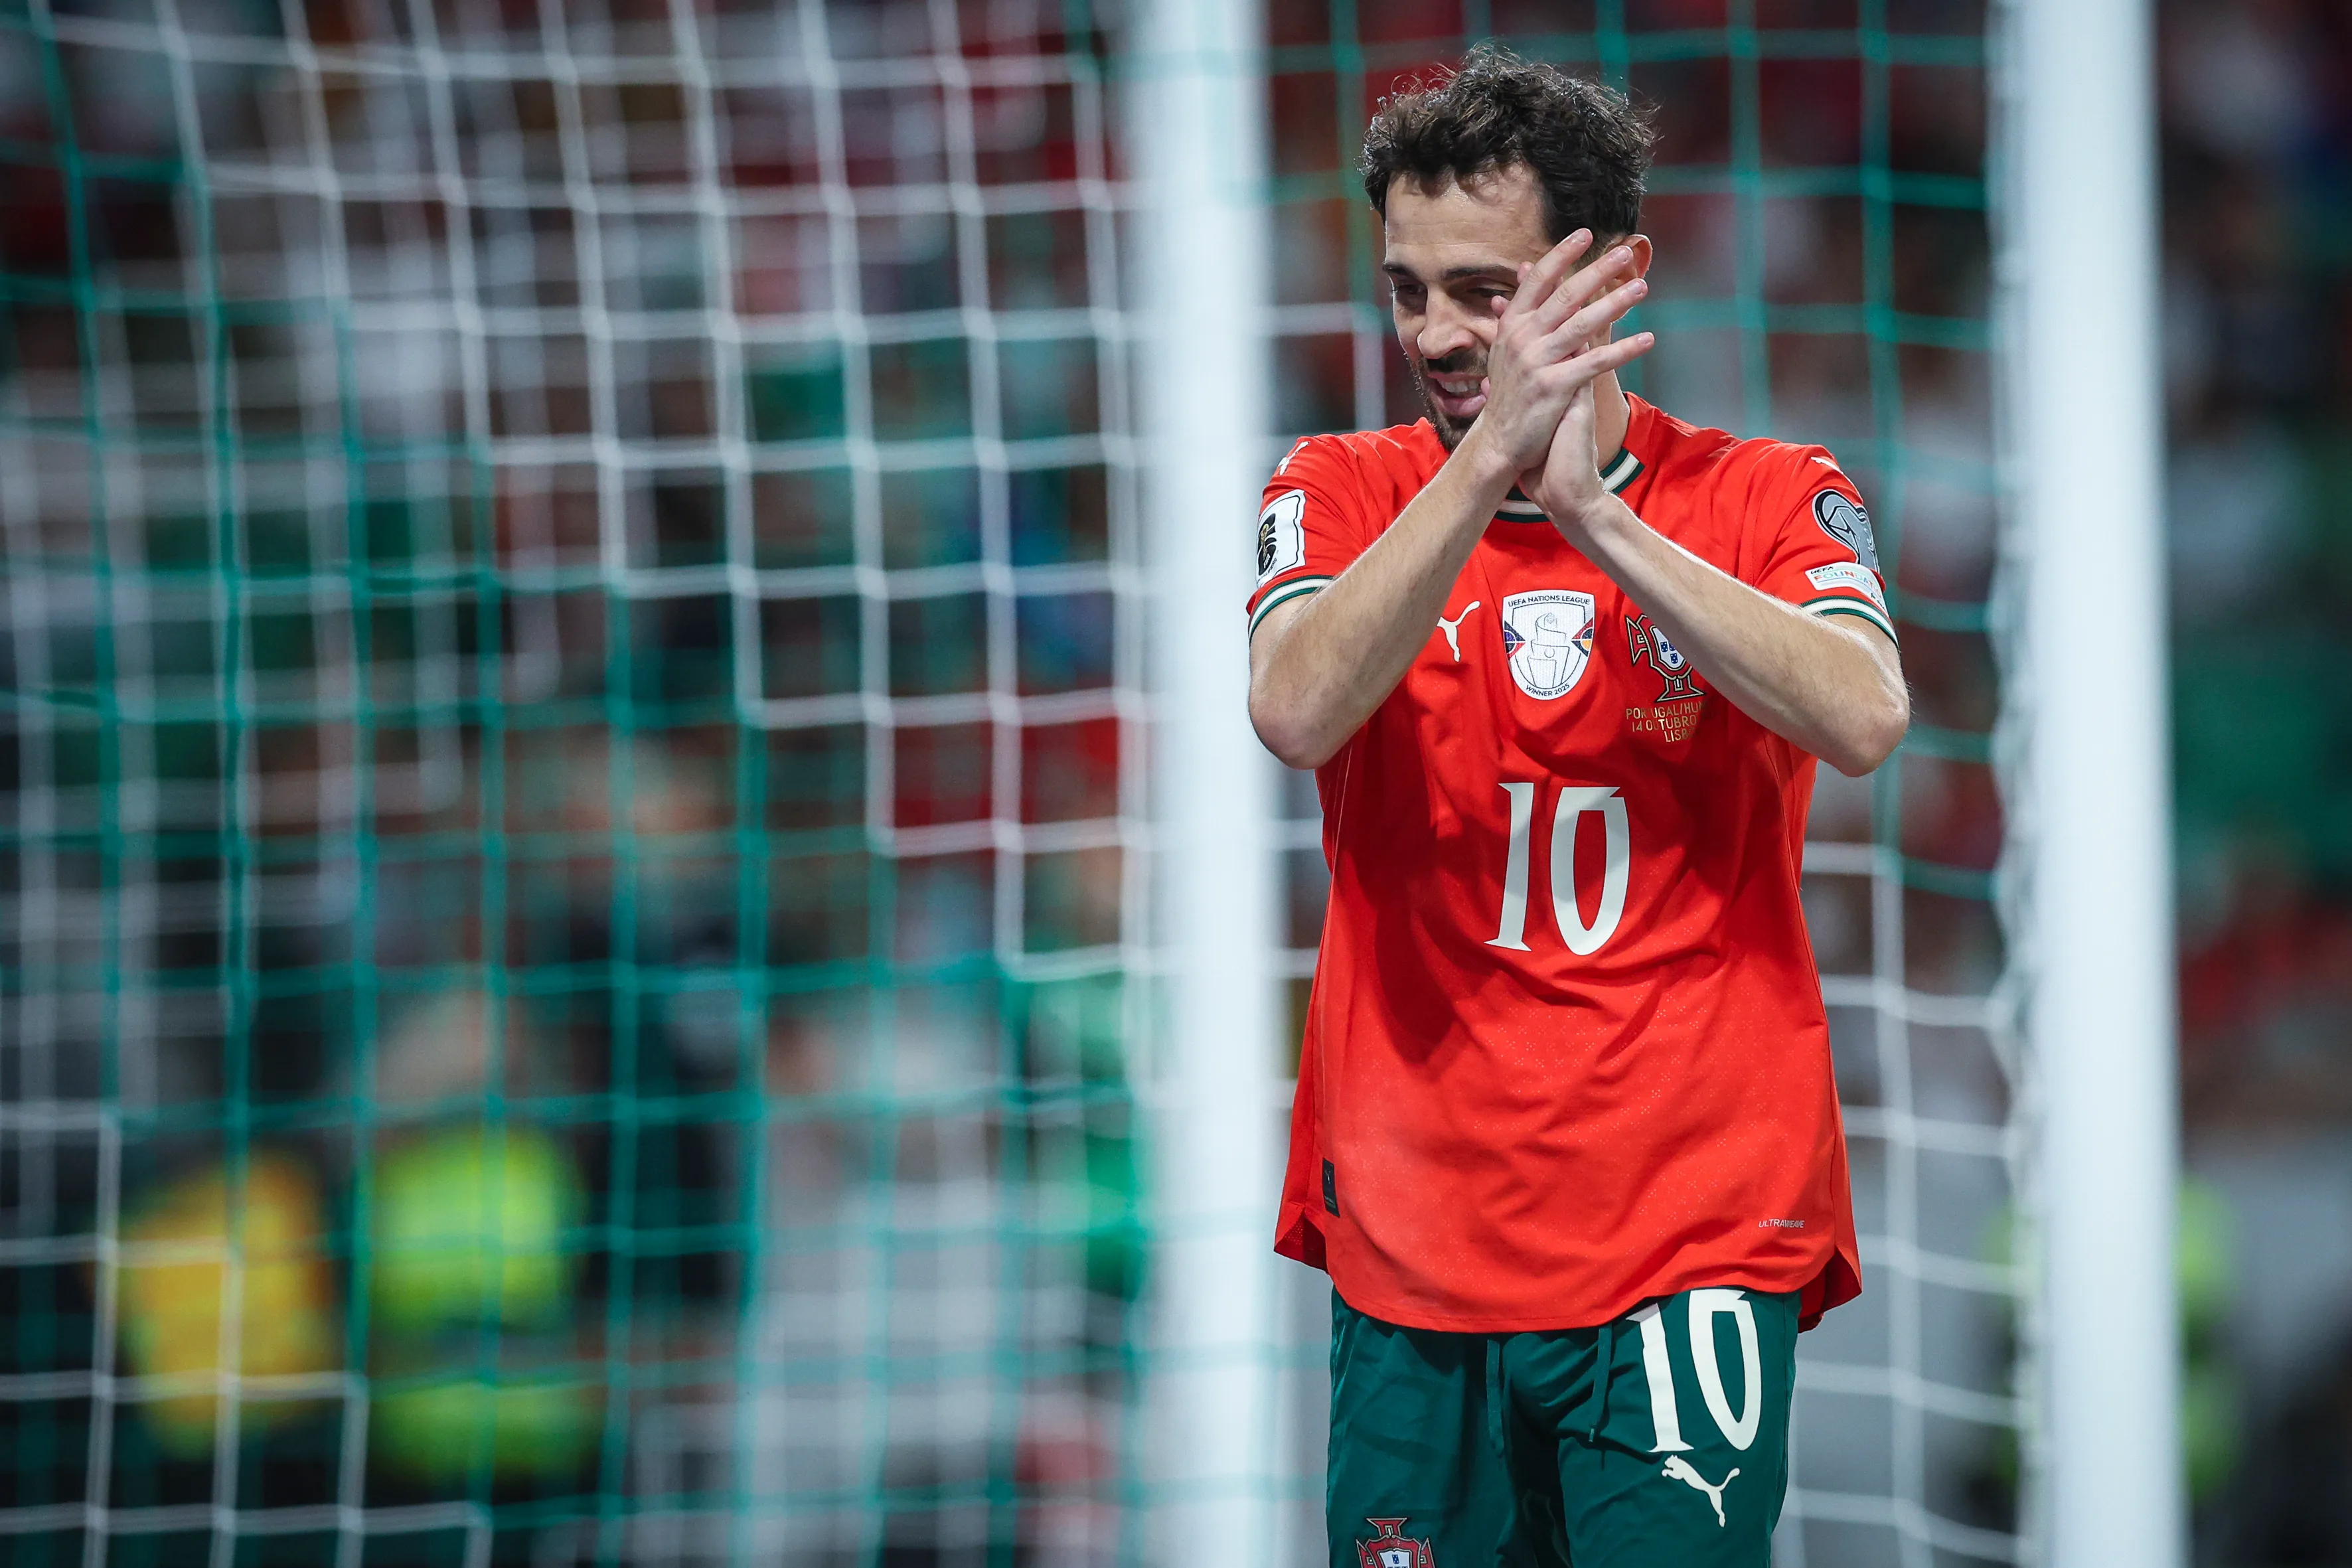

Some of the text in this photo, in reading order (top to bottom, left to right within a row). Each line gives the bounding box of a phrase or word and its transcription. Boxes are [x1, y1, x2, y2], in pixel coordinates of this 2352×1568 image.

[1810, 566, 1834, 574] UEFA
[1508, 595, 1591, 607] UEFA NATIONS LEAGUE
[1525, 683, 1570, 696] WINNER 2025
[1632, 714, 1697, 732] 14 OUTUBRO
[1484, 782, 1630, 956] 10
[1758, 1218, 1805, 1229] ULTRAWEAVE
[1626, 1288, 1763, 1453] 10
